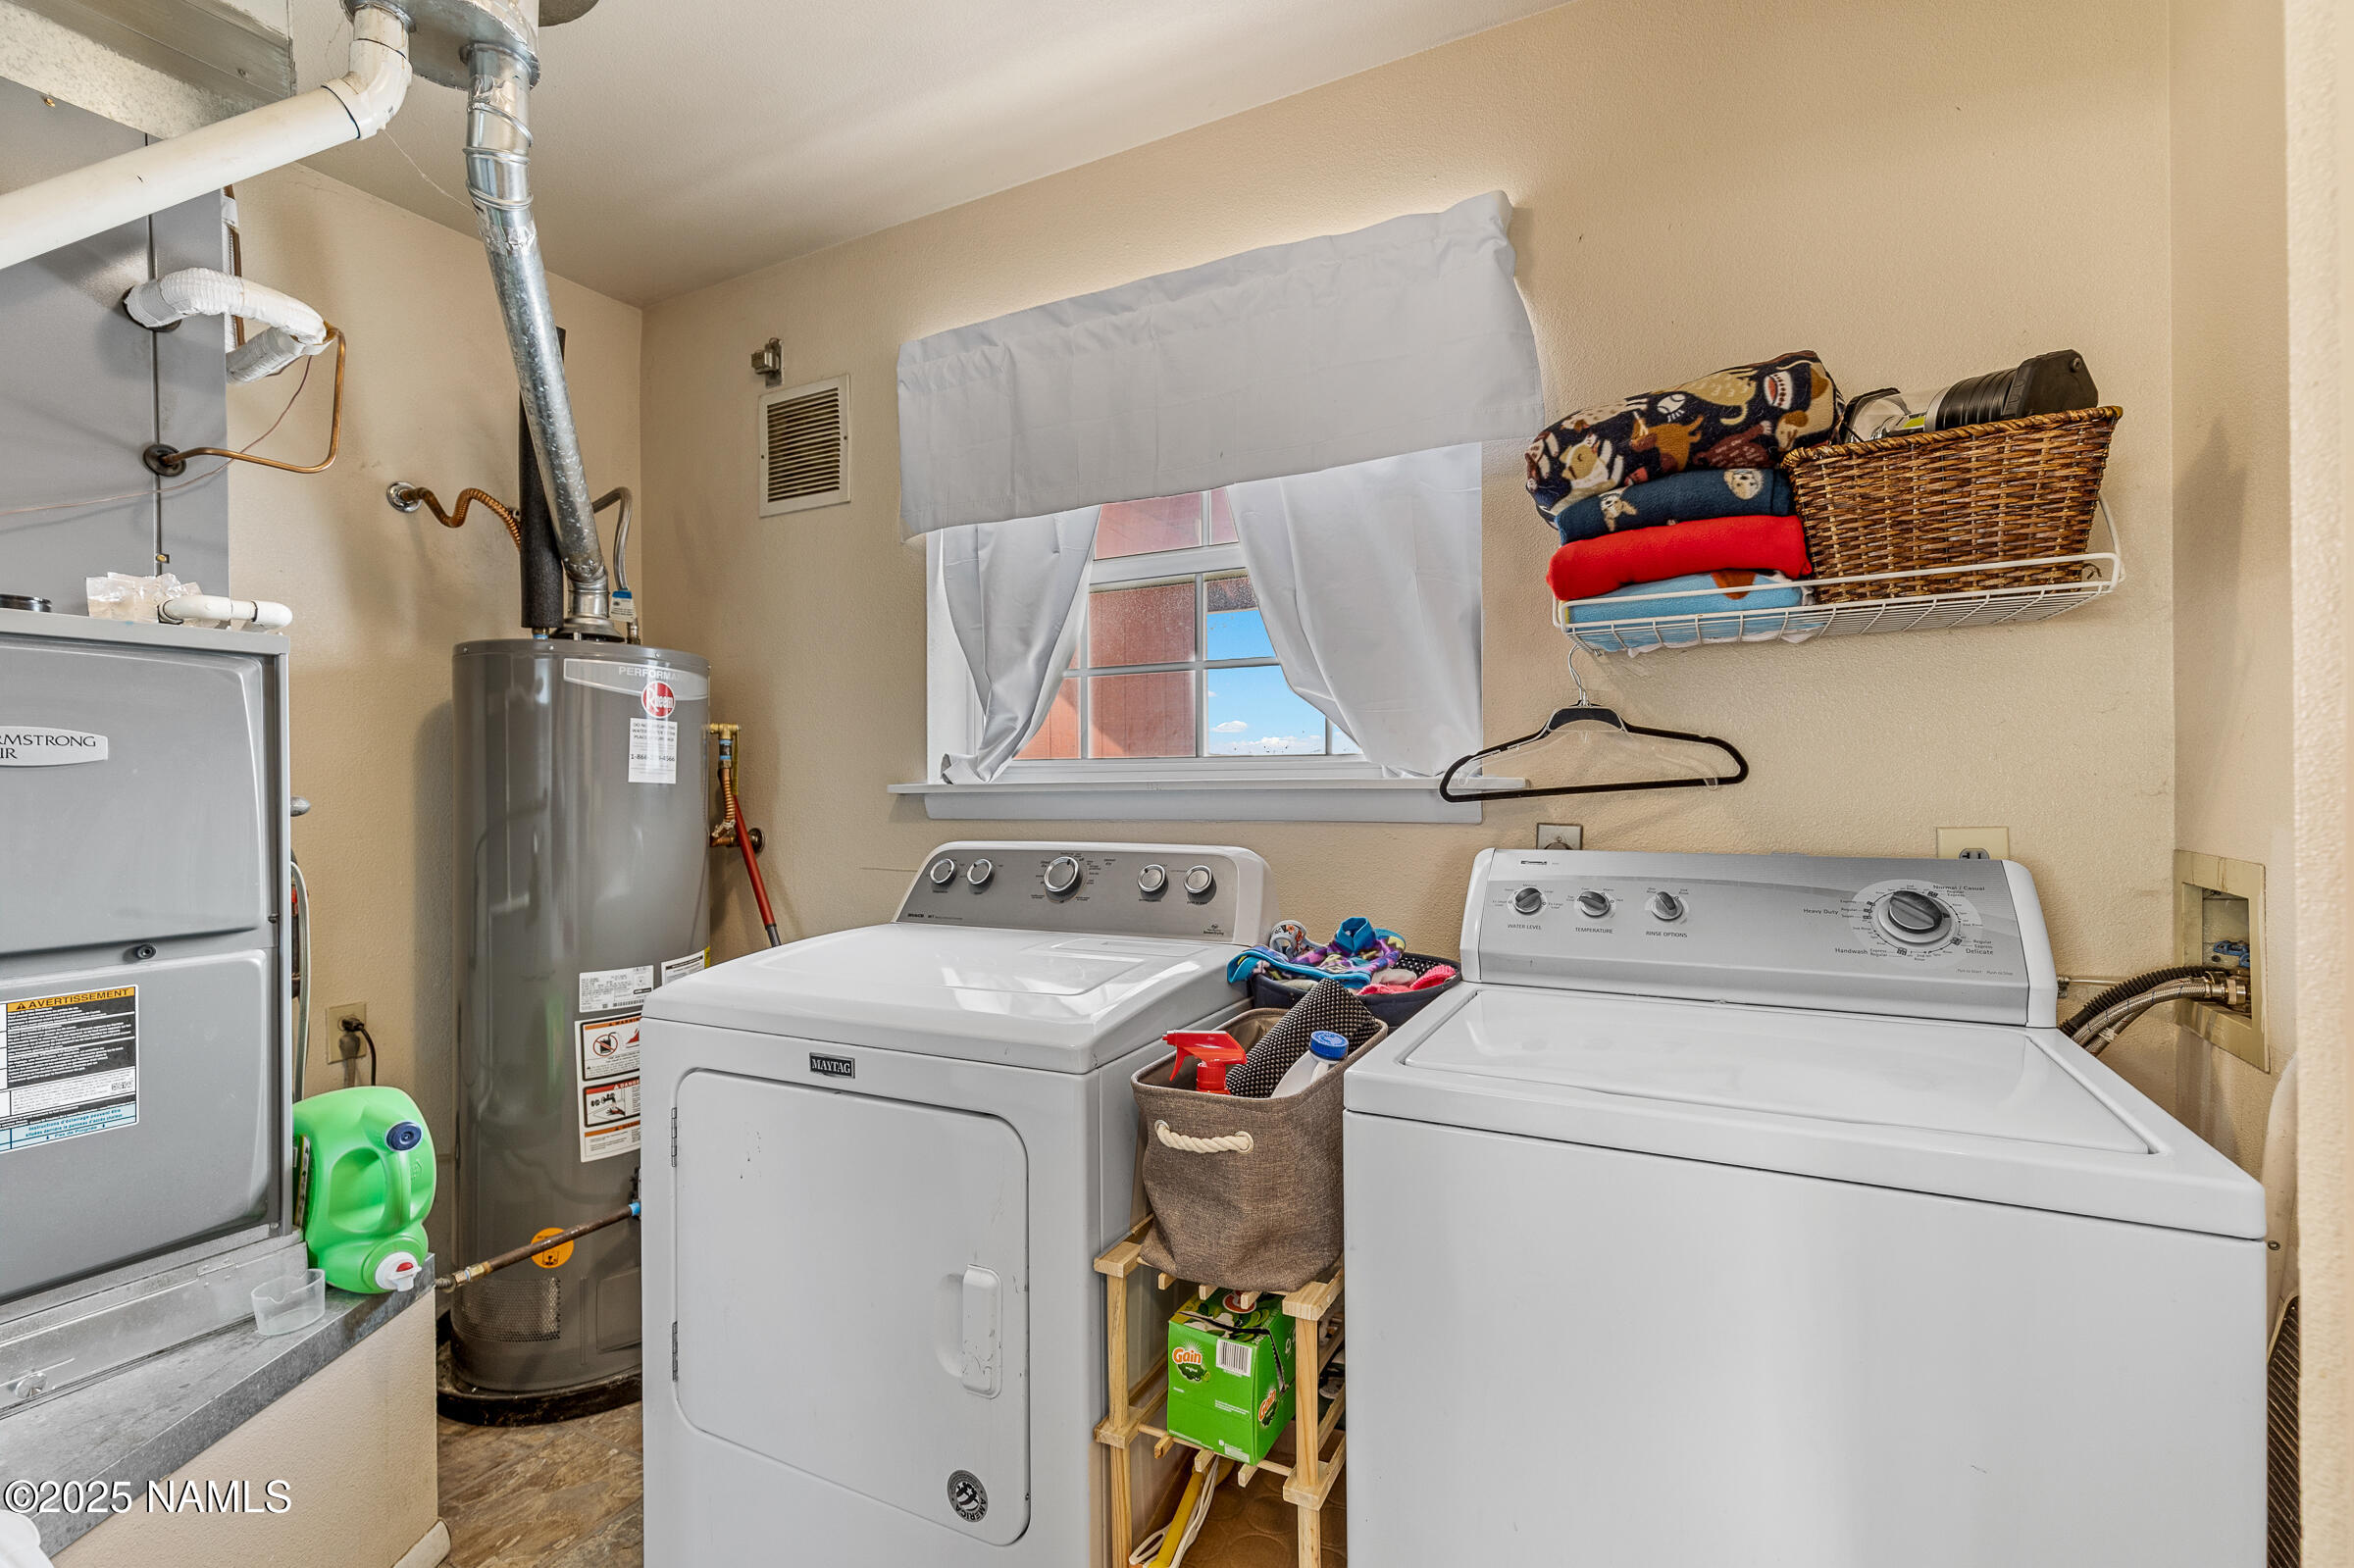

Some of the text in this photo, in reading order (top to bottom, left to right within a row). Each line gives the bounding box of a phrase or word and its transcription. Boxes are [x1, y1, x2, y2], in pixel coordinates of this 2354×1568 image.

[645, 683, 674, 712] Rheem
[0, 747, 18, 759] IR
[28, 988, 128, 1009] AVERTISSEMENT
[811, 1058, 851, 1074] MAYTAG
[1172, 1347, 1203, 1365] Gain
[1258, 1389, 1276, 1421] Gain
[955, 1497, 987, 1521] AMERICA
